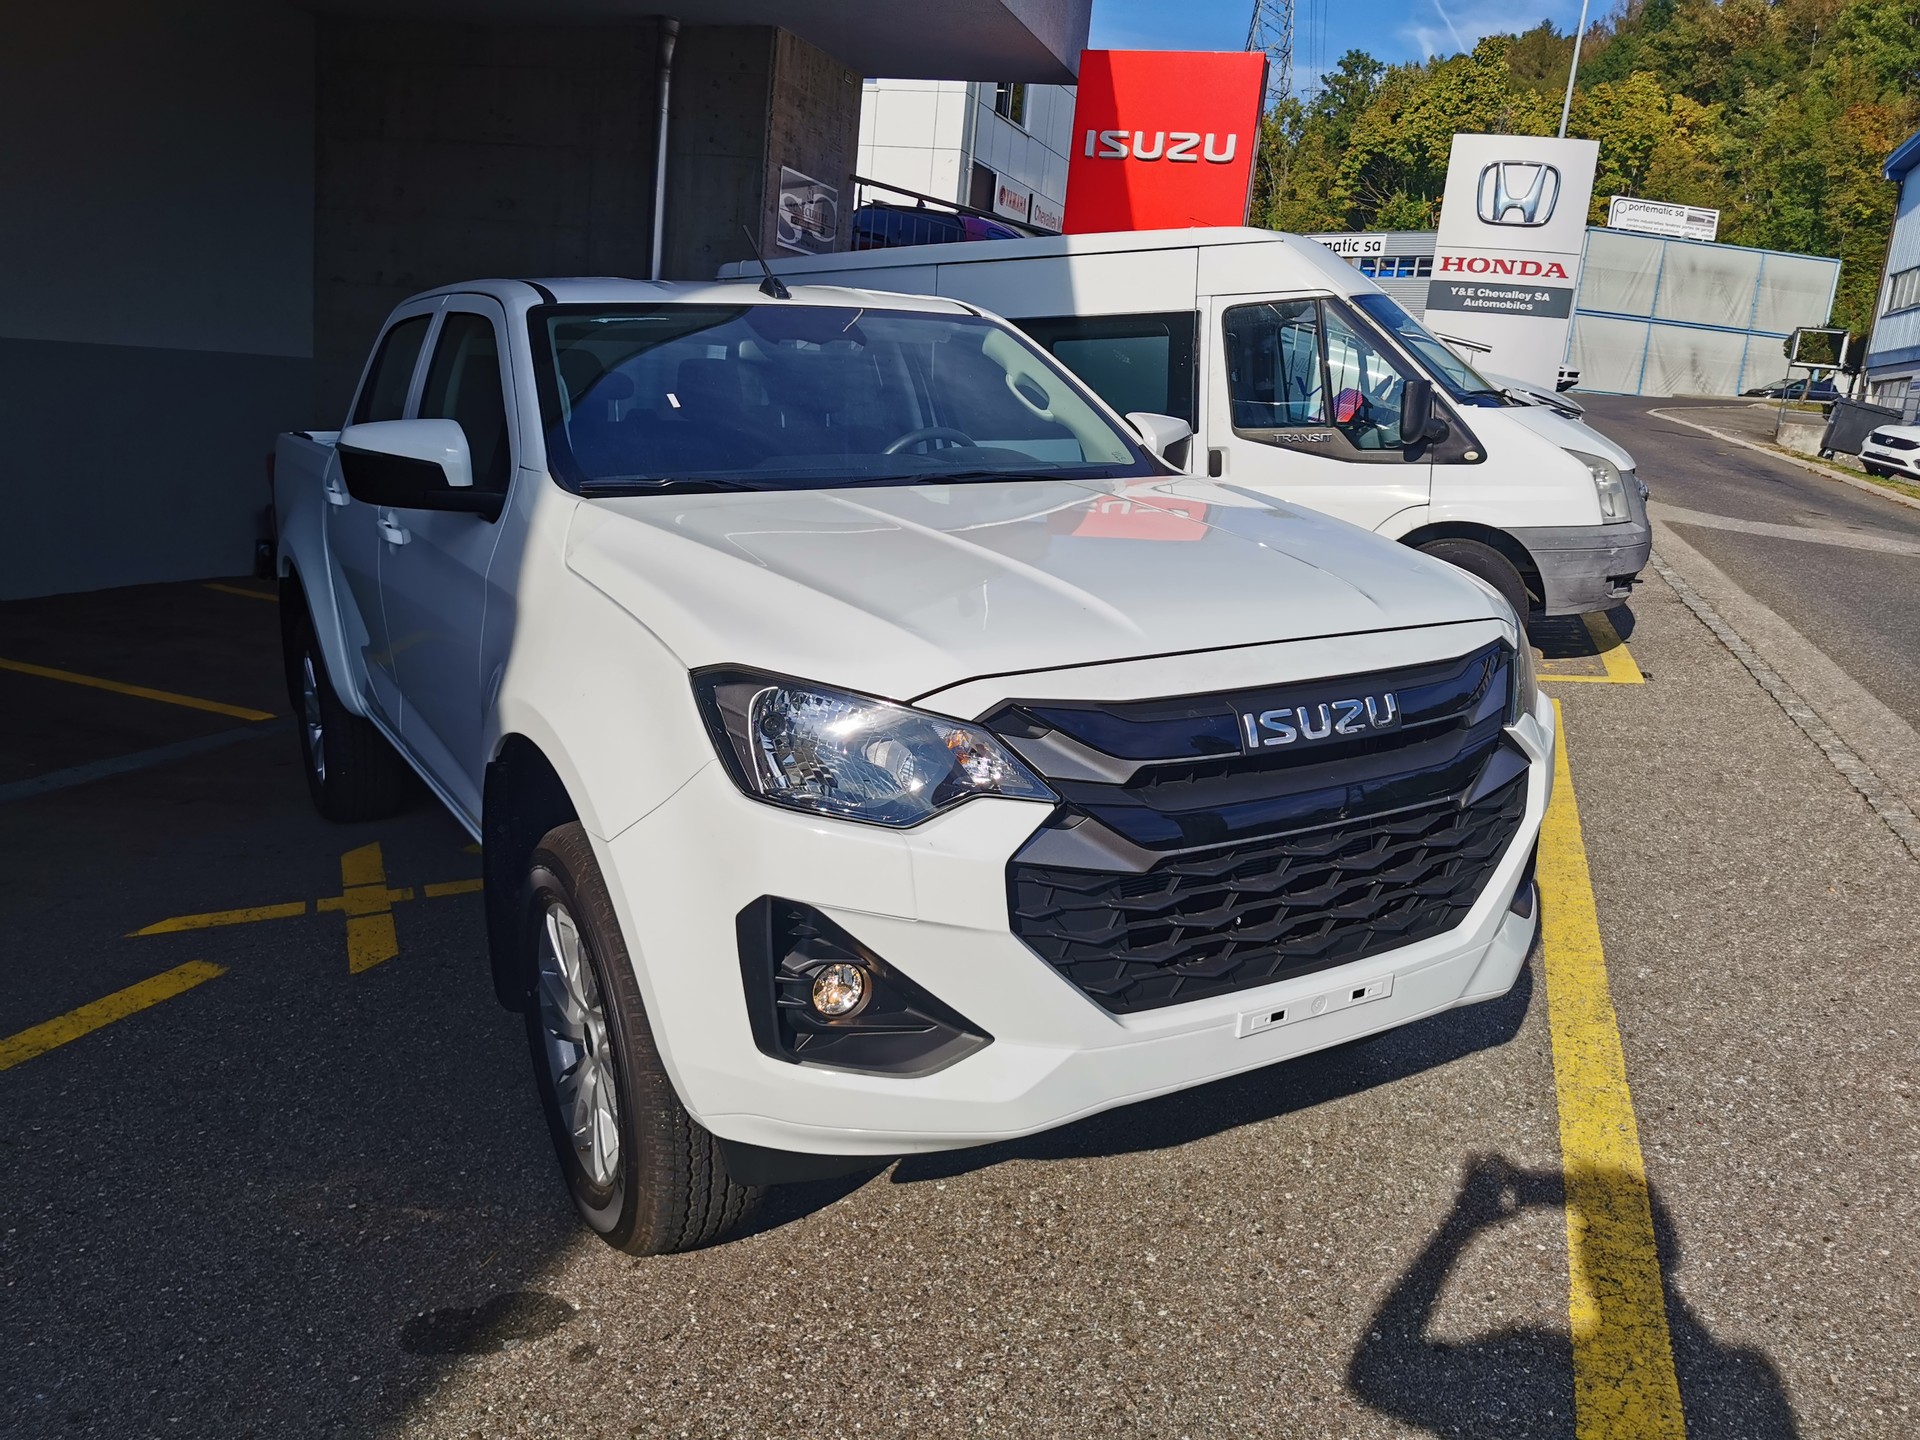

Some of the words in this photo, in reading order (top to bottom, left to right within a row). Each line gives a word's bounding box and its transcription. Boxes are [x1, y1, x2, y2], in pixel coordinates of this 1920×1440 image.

[1085, 130, 1237, 163] ISUZU
[1628, 203, 1673, 216] portematic
[1363, 240, 1381, 252] sa
[1439, 256, 1569, 279] HONDA
[1450, 286, 1475, 297] Y&E
[1477, 288, 1532, 302] Chevalley
[1534, 292, 1550, 302] SA
[1463, 298, 1533, 311] Automobiles
[1273, 433, 1333, 443] TRANSIT
[1243, 693, 1397, 748] ISUZU
